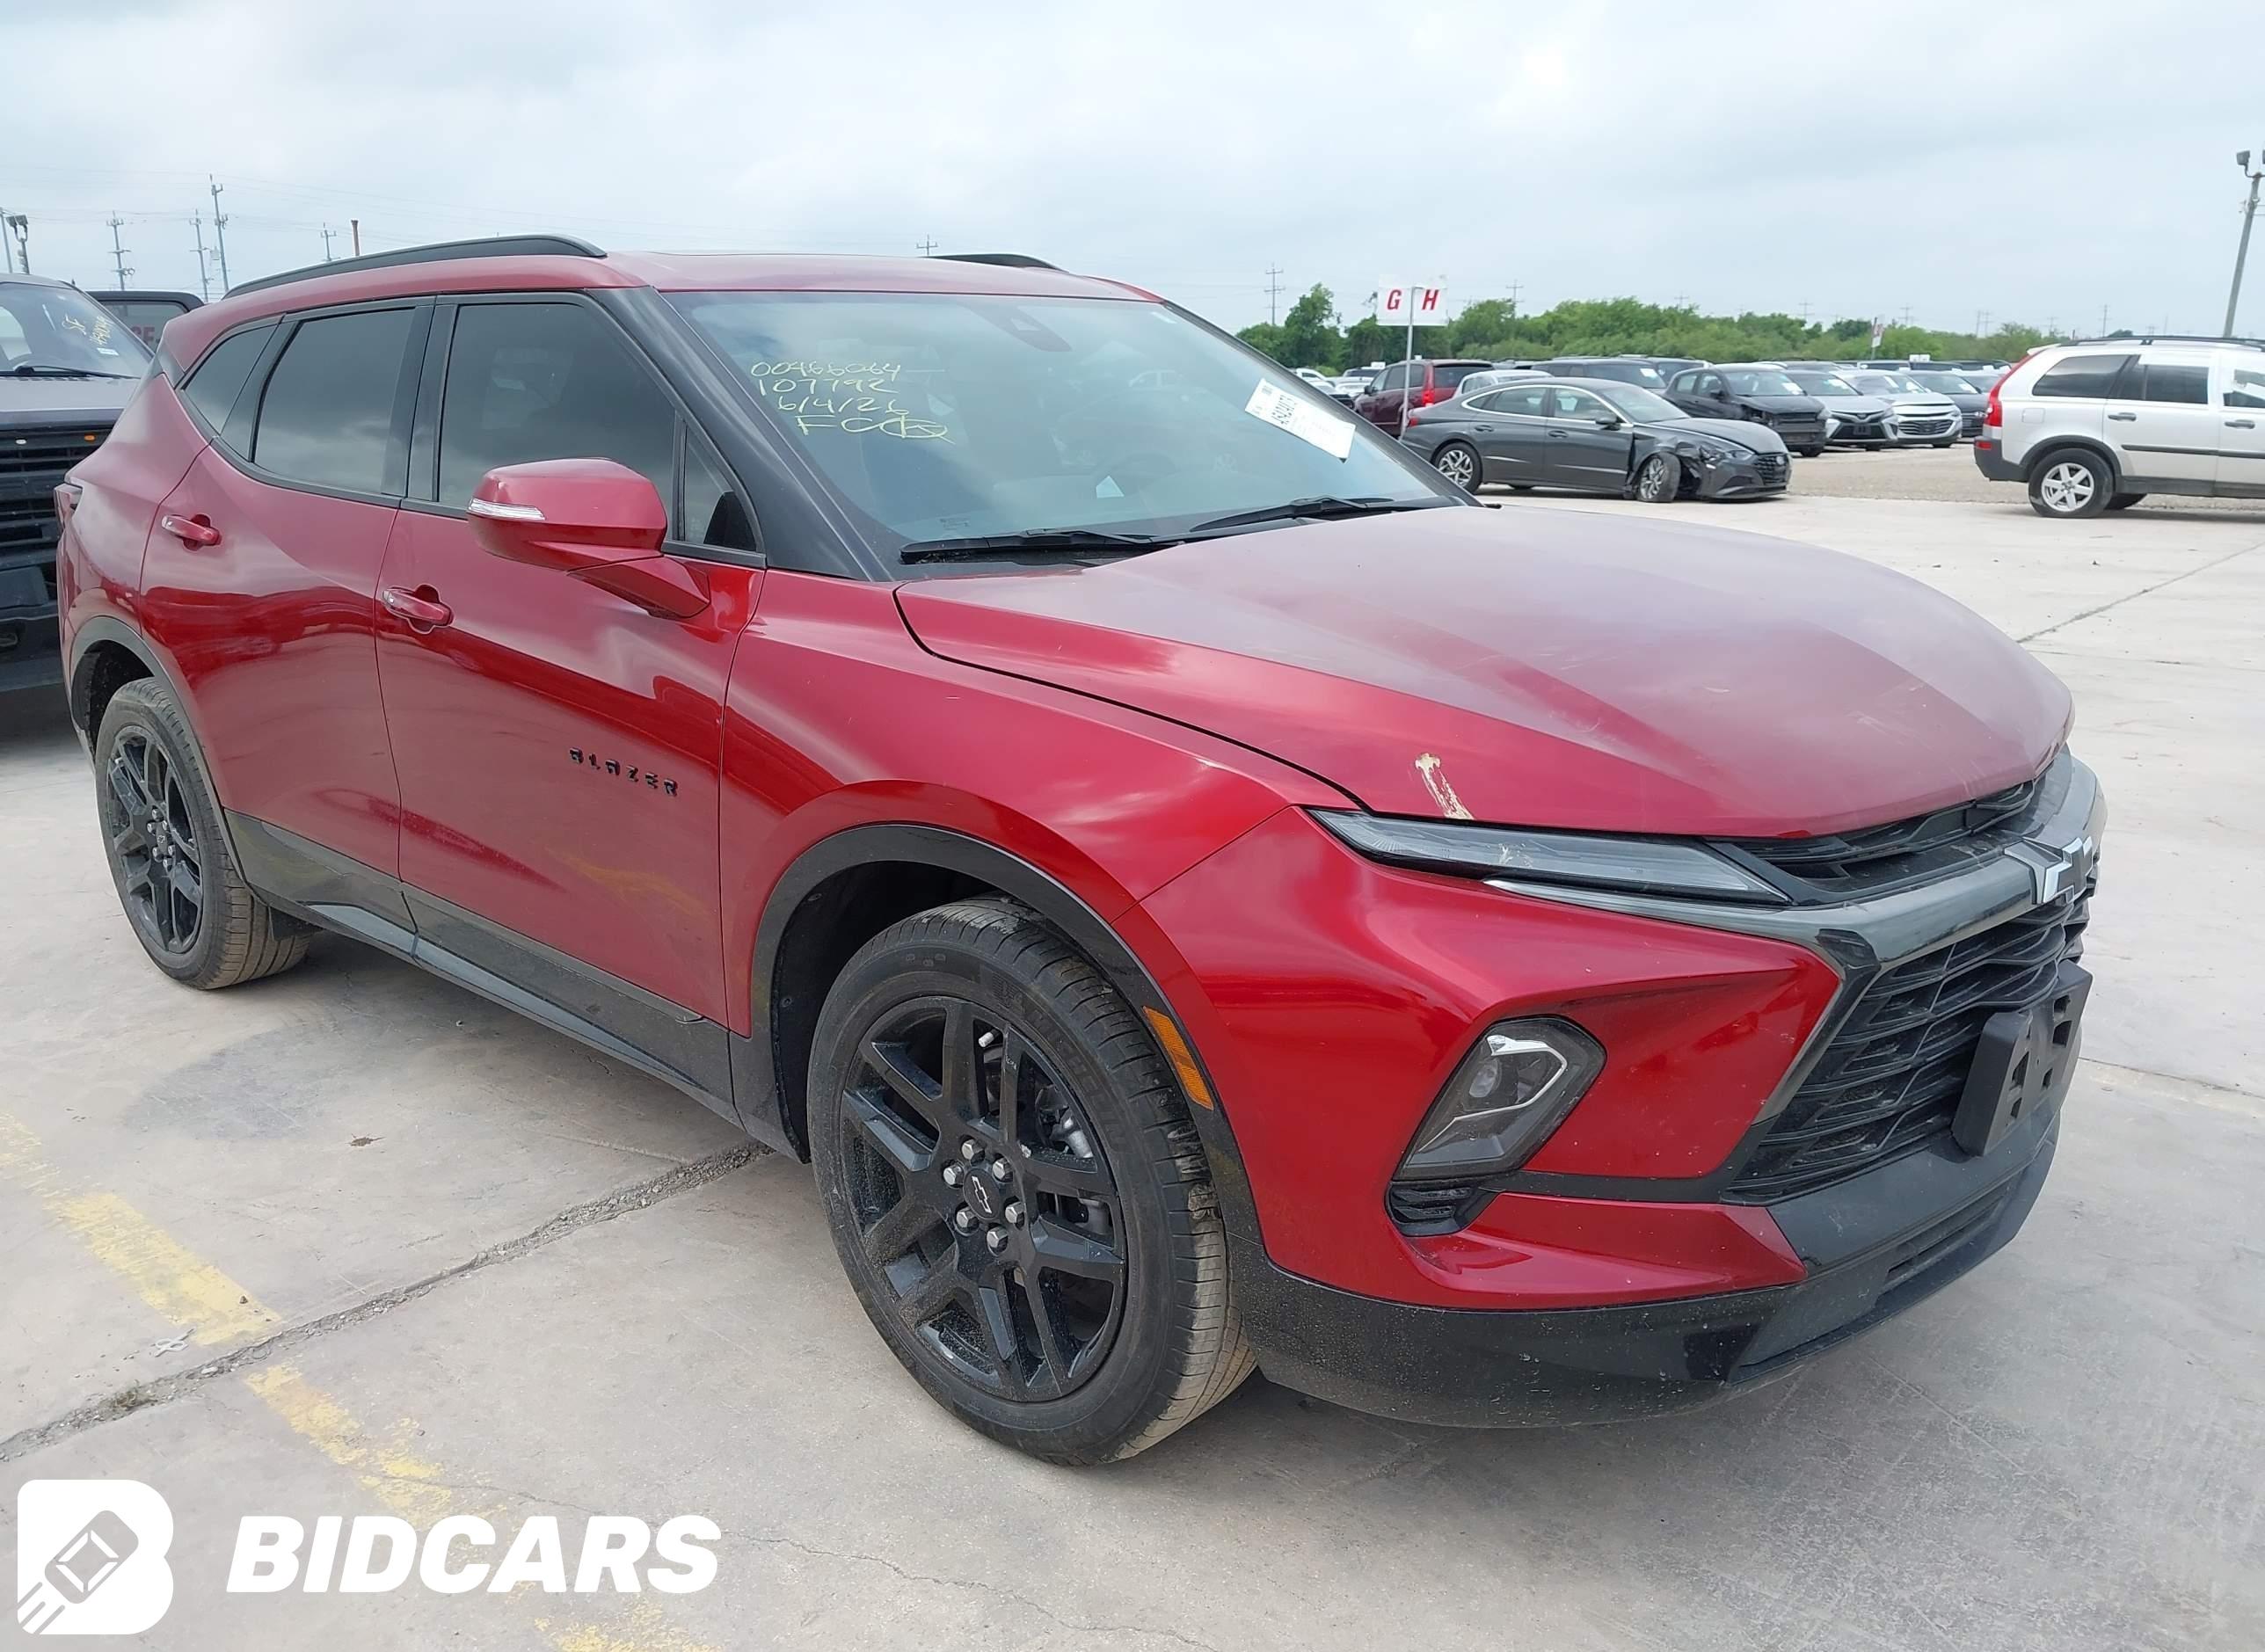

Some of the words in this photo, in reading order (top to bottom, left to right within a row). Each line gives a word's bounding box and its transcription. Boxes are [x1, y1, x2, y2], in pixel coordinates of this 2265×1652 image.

[1387, 288, 1402, 310] G
[1422, 288, 1439, 310] H
[569, 746, 678, 797] BLAZER
